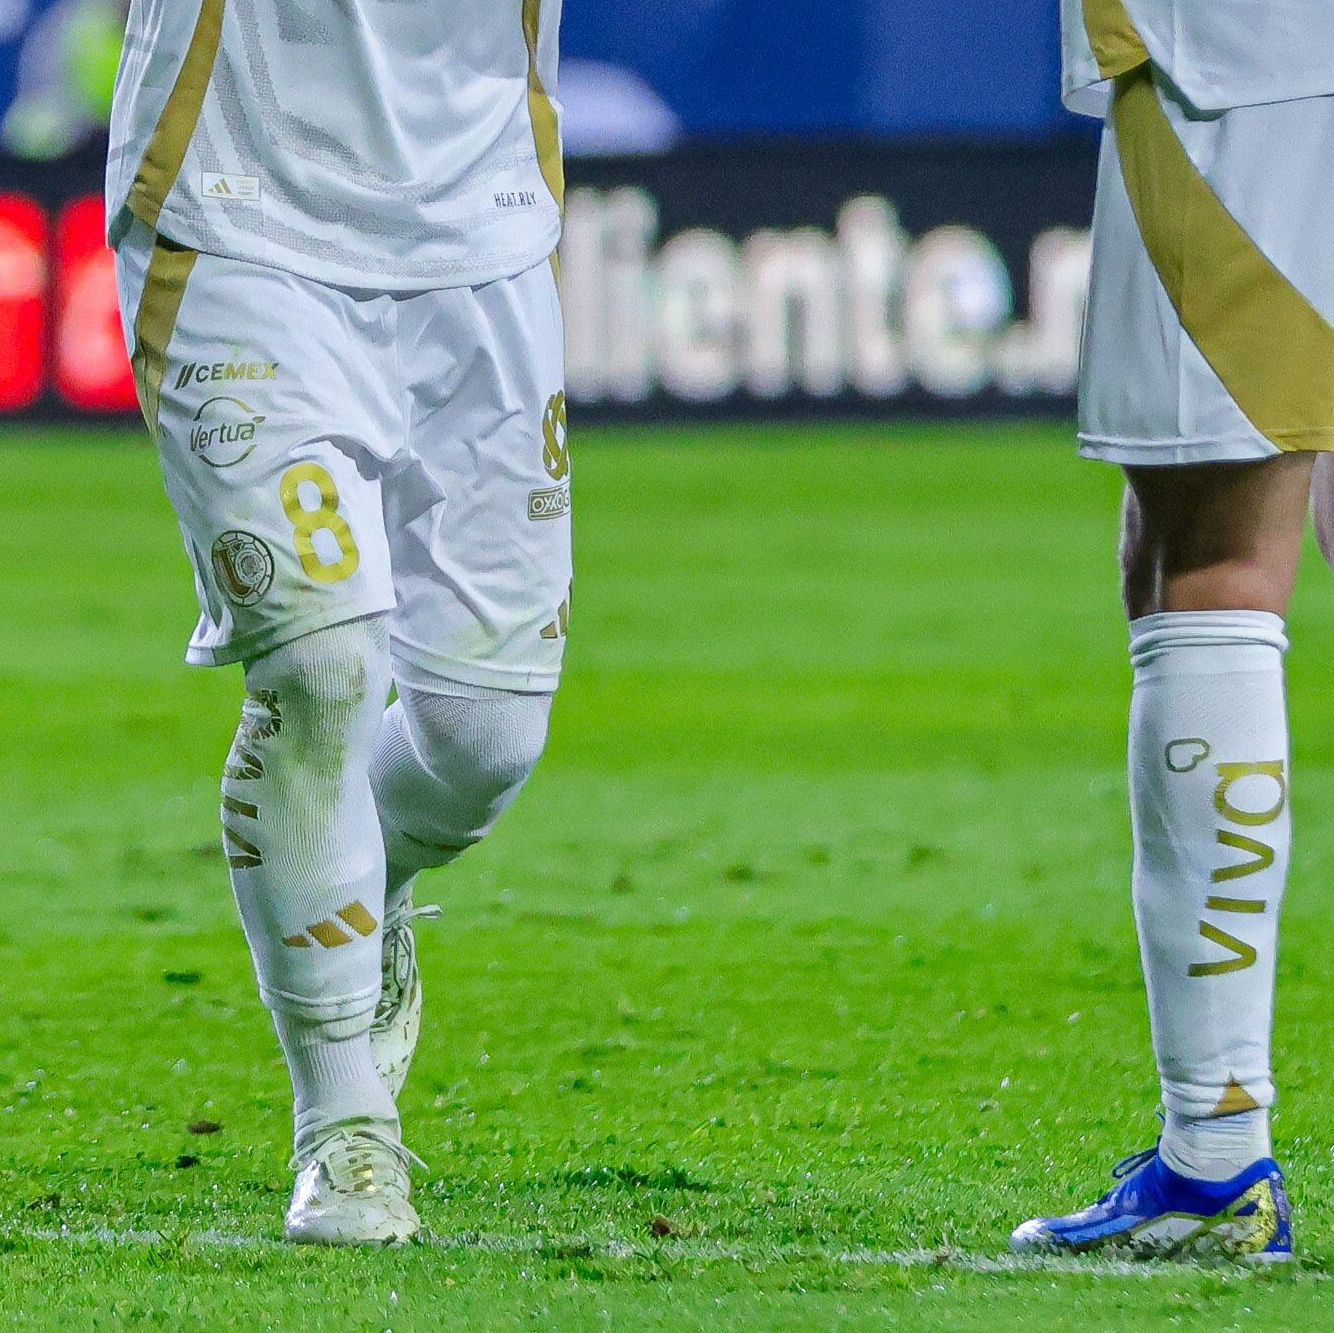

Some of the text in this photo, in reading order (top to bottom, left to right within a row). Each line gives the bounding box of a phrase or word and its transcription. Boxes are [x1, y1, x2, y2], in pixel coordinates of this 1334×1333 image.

[195, 363, 279, 383] CEMEX
[190, 422, 256, 452] Vertua
[279, 462, 360, 584] 8
